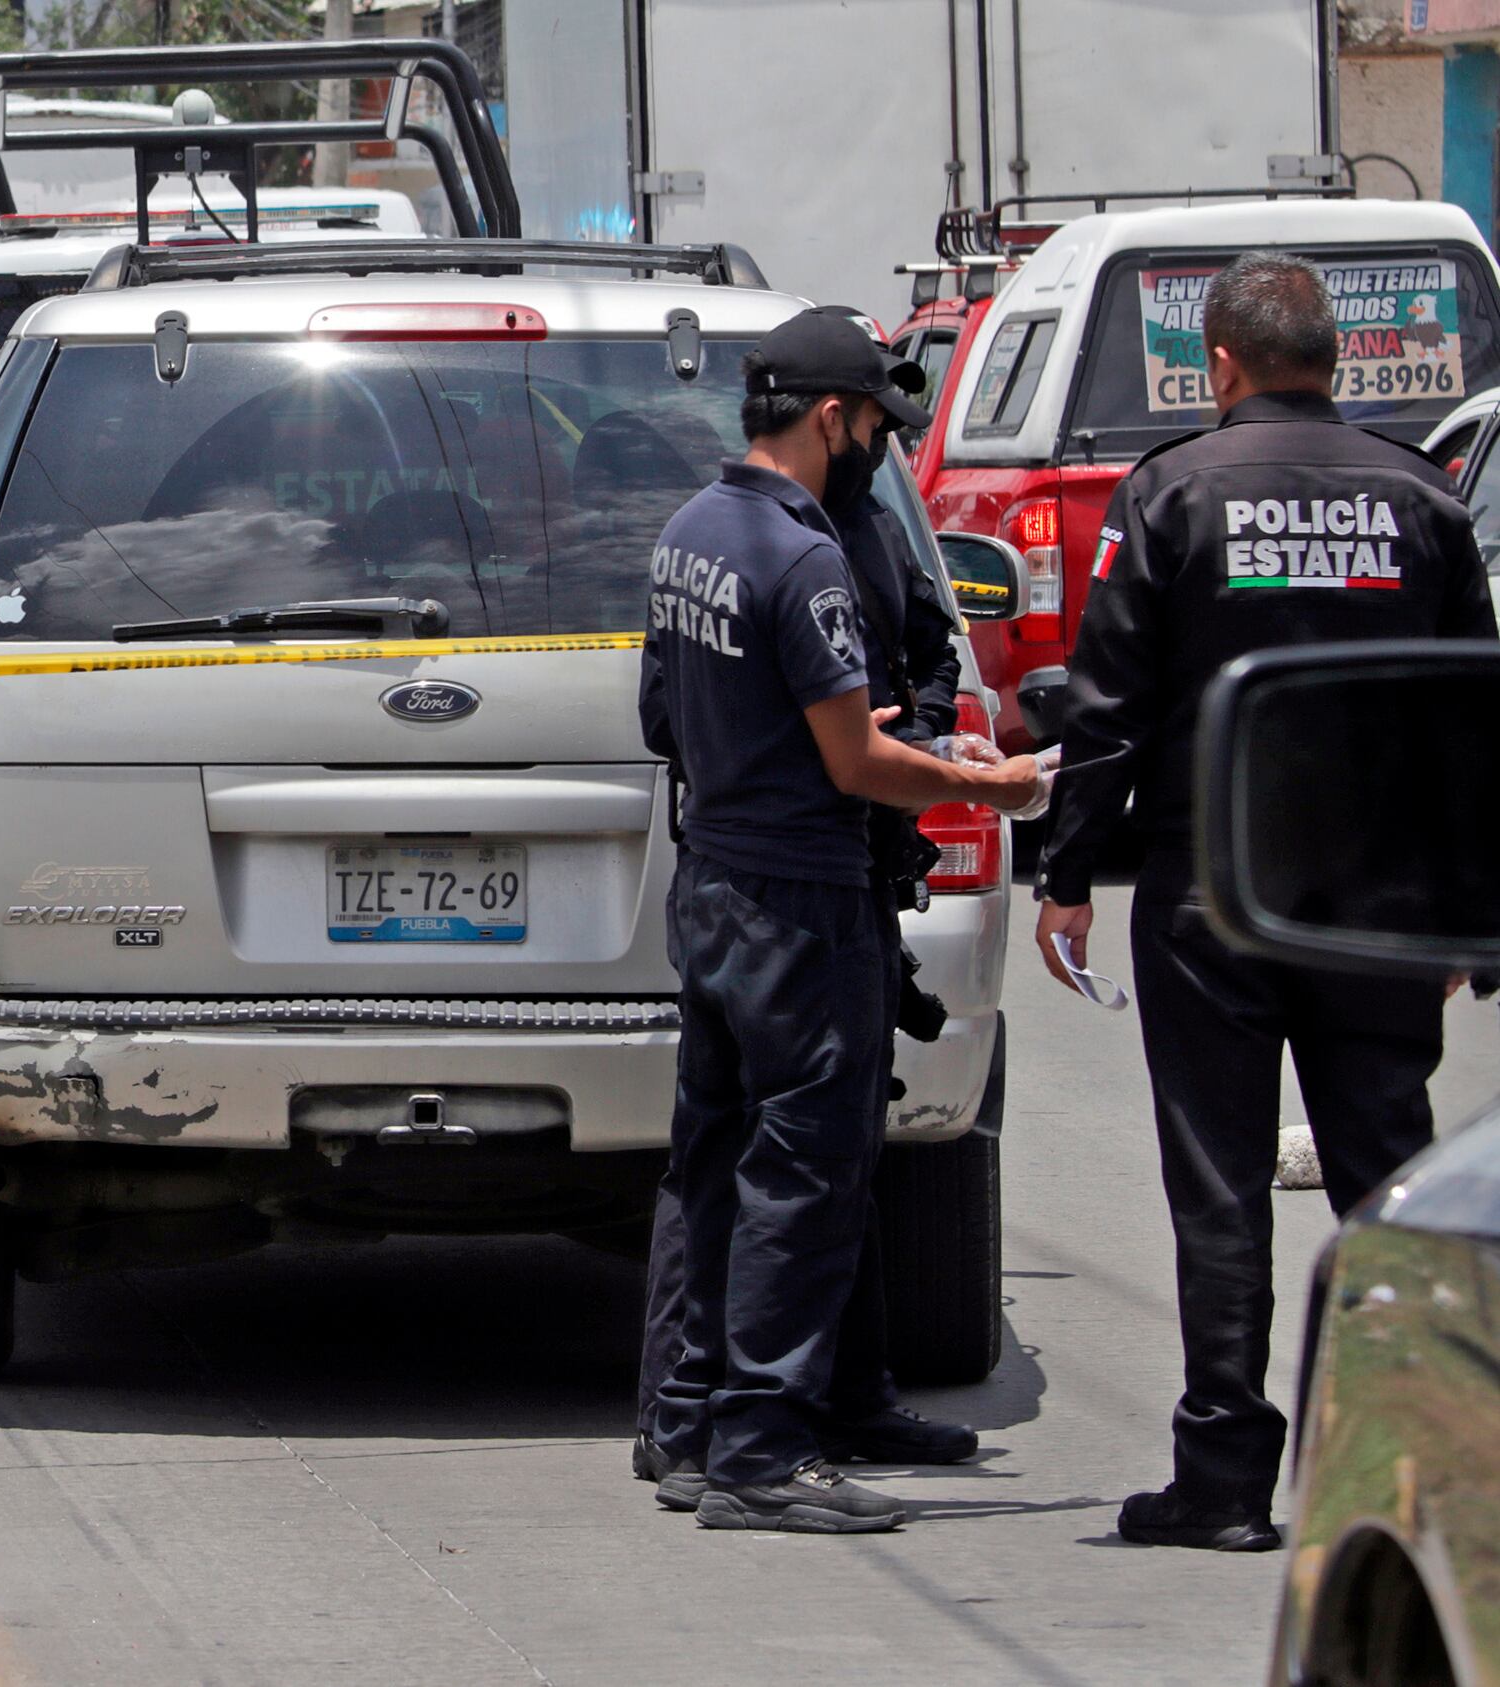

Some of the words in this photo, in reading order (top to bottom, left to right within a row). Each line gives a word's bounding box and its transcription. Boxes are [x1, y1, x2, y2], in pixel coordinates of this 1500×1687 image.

[1155, 275, 1210, 303] ENV
[1324, 264, 1442, 297] QUETERIA
[1161, 303, 1182, 332] A
[1331, 362, 1454, 397] 73-8996
[1225, 494, 1399, 536] POLICÍA
[1226, 538, 1401, 578] ESTATAL
[650, 545, 739, 616] OLICÍA
[650, 592, 744, 658] STATAL
[406, 688, 455, 711] Ford
[335, 871, 519, 912] TZE-72-69
[3, 905, 187, 926] EXPLORER
[400, 919, 451, 930] PUEBLA
[119, 932, 158, 944] XLT
